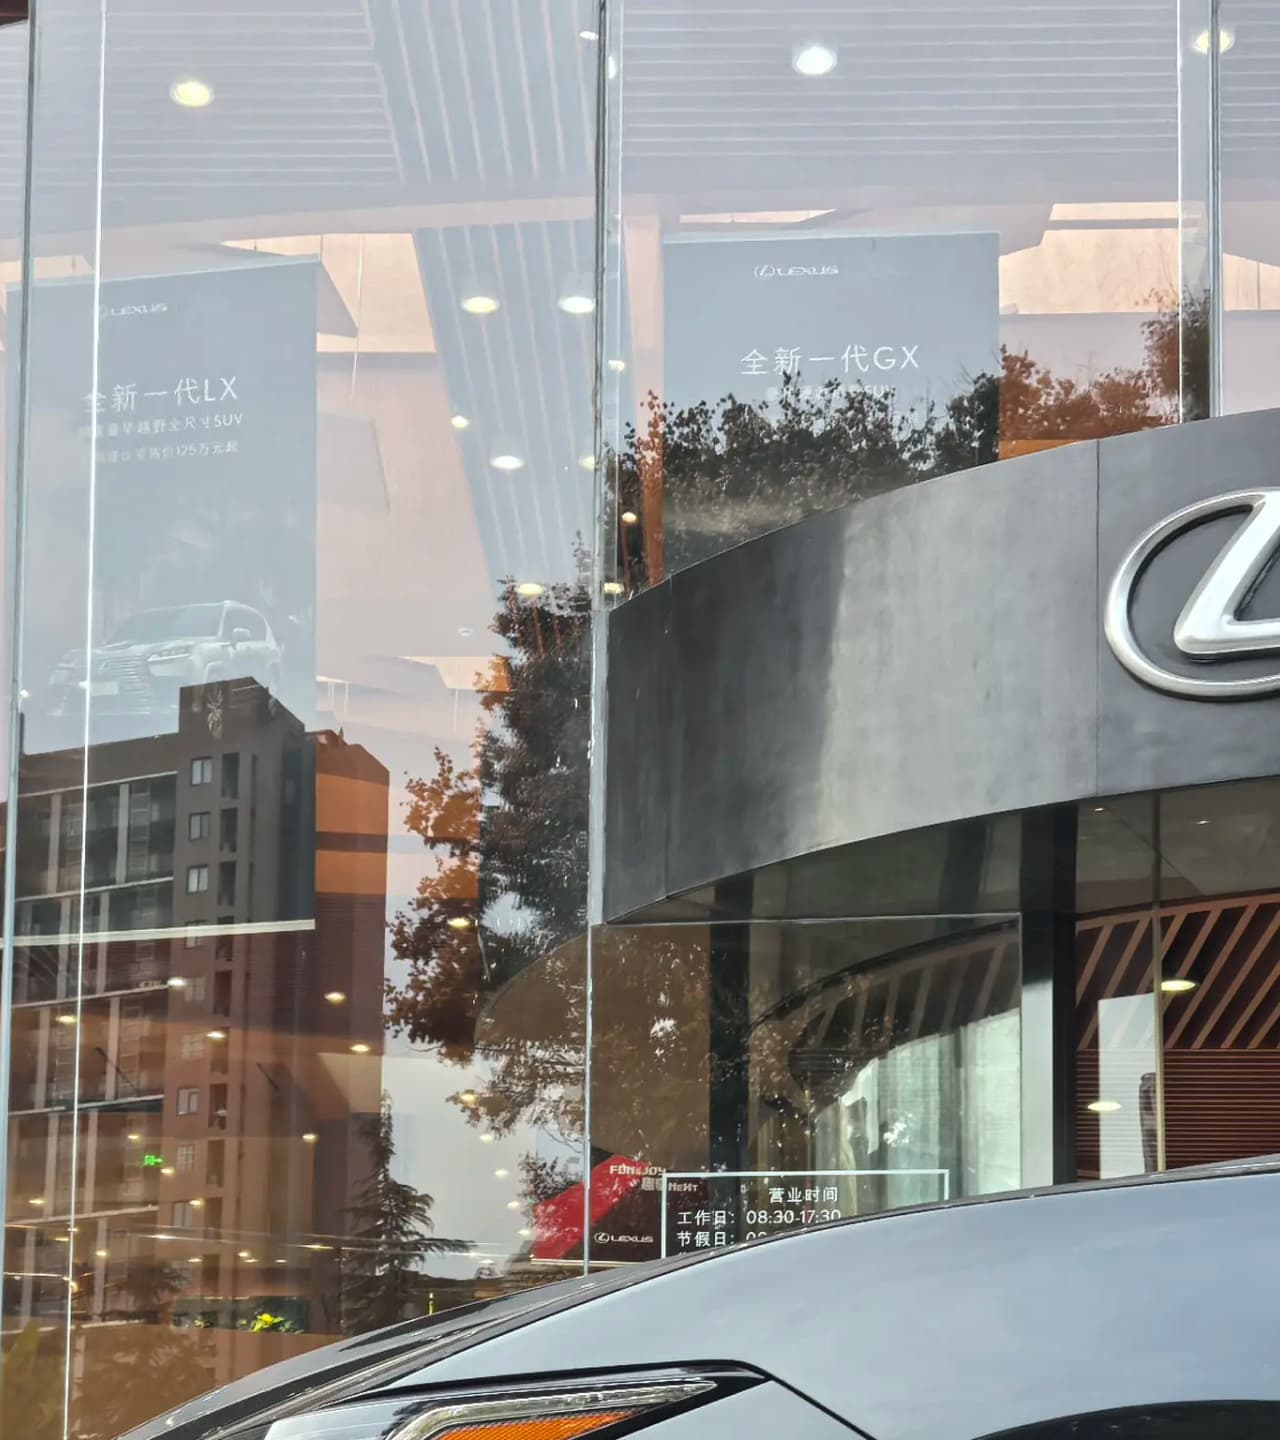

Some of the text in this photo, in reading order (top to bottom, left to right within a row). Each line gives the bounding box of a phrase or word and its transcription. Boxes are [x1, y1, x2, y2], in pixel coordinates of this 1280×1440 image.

[776, 265, 840, 276] LEXUS
[739, 343, 920, 376] 全新一代GX
[80, 376, 238, 413] 全新一代LX
[768, 1186, 838, 1203] 营业时间
[610, 1234, 654, 1243] LEXUS
